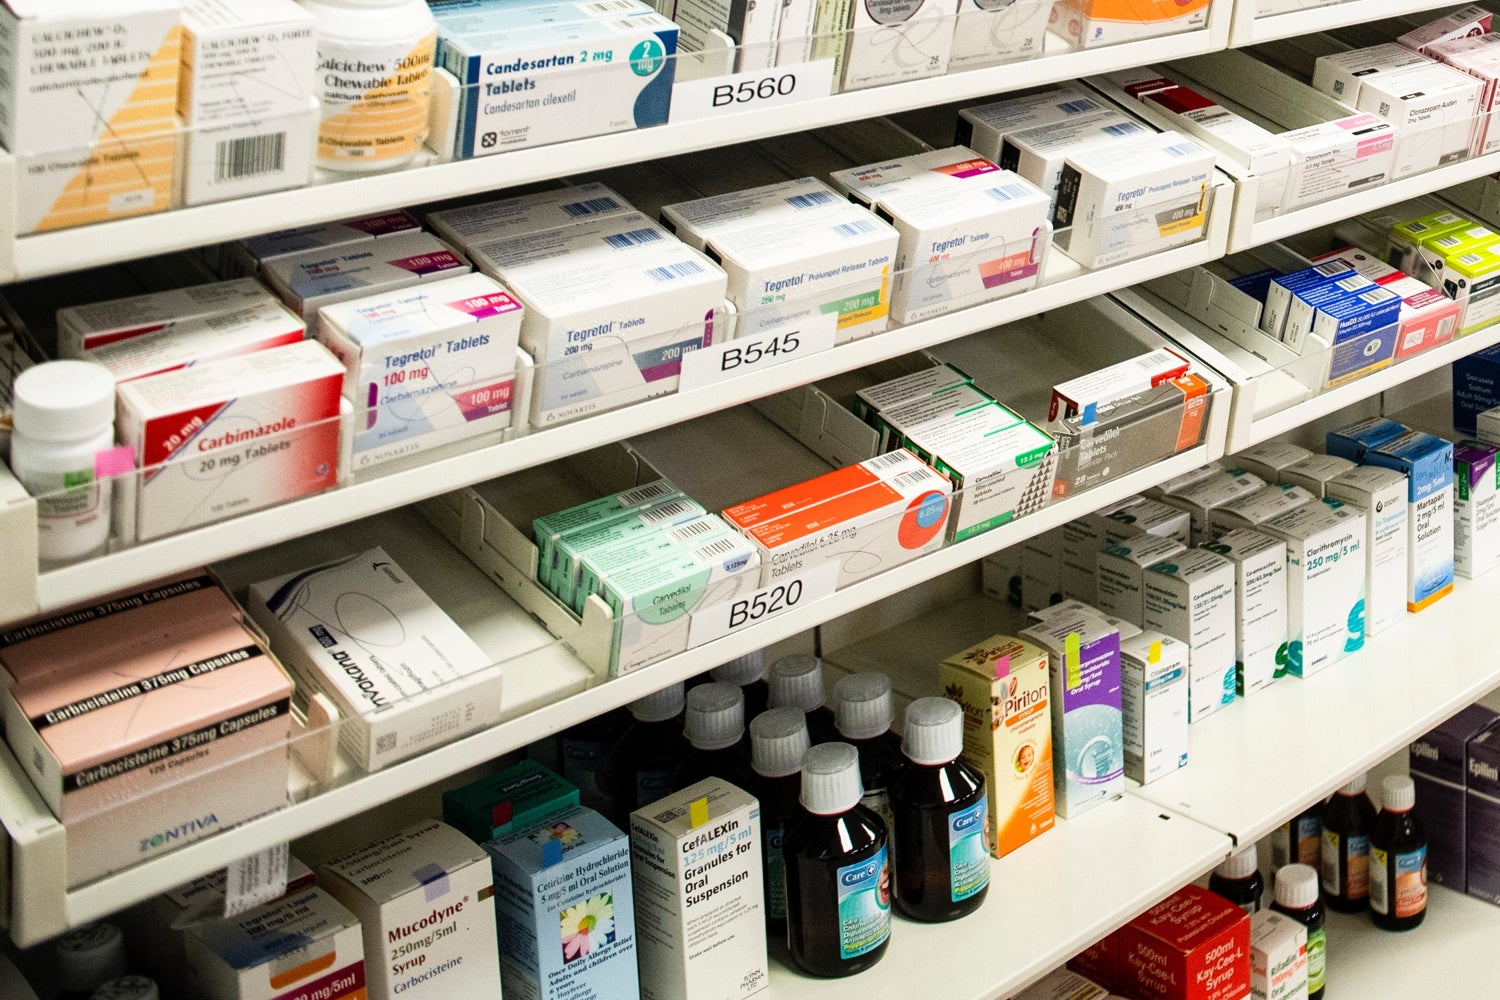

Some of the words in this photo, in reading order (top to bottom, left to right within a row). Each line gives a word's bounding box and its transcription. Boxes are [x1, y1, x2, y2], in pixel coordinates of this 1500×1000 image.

[486, 53, 575, 77] Candesartan
[579, 51, 589, 65] 2
[592, 47, 614, 64] mg
[324, 72, 393, 90] Chewable
[485, 79, 536, 98] Tablets
[711, 73, 798, 108] B560
[484, 96, 541, 117] Candesartan
[542, 89, 577, 107] cilexetil
[764, 274, 804, 293] Tegretol
[838, 261, 867, 276] Release
[867, 256, 889, 269] Tablets
[385, 345, 436, 370] Tegretol
[447, 334, 491, 356] Tablets
[721, 332, 801, 371] B545
[383, 369, 405, 386] 100
[408, 365, 429, 383] mg
[198, 415, 297, 453] Carbimazole
[199, 458, 217, 473] 20
[219, 453, 242, 471] mg
[244, 438, 292, 461] Tablets
[1416, 491, 1446, 511] Martapan
[772, 539, 818, 566] Carvedilol
[1307, 533, 1354, 558] Clarithromycin
[729, 579, 804, 629] B520
[1005, 685, 1047, 714] Piriton
[76, 744, 170, 788] Carbocisteine
[171, 727, 218, 756] 375mg
[219, 703, 279, 734] Capsules
[1469, 757, 1499, 781] Epilim
[682, 818, 740, 854] CefALEXin
[537, 872, 575, 894] Cetirizine
[575, 848, 629, 878] Hydrochloride
[683, 850, 704, 869] 125
[684, 850, 734, 881] Granules
[735, 839, 753, 856] for
[684, 875, 709, 895] Oral
[686, 870, 750, 908] Suspension
[844, 870, 866, 883] Care
[1205, 937, 1235, 966] 500ml
[1197, 949, 1243, 985] Kay-Cee-L
[1206, 966, 1235, 996] Syrup
